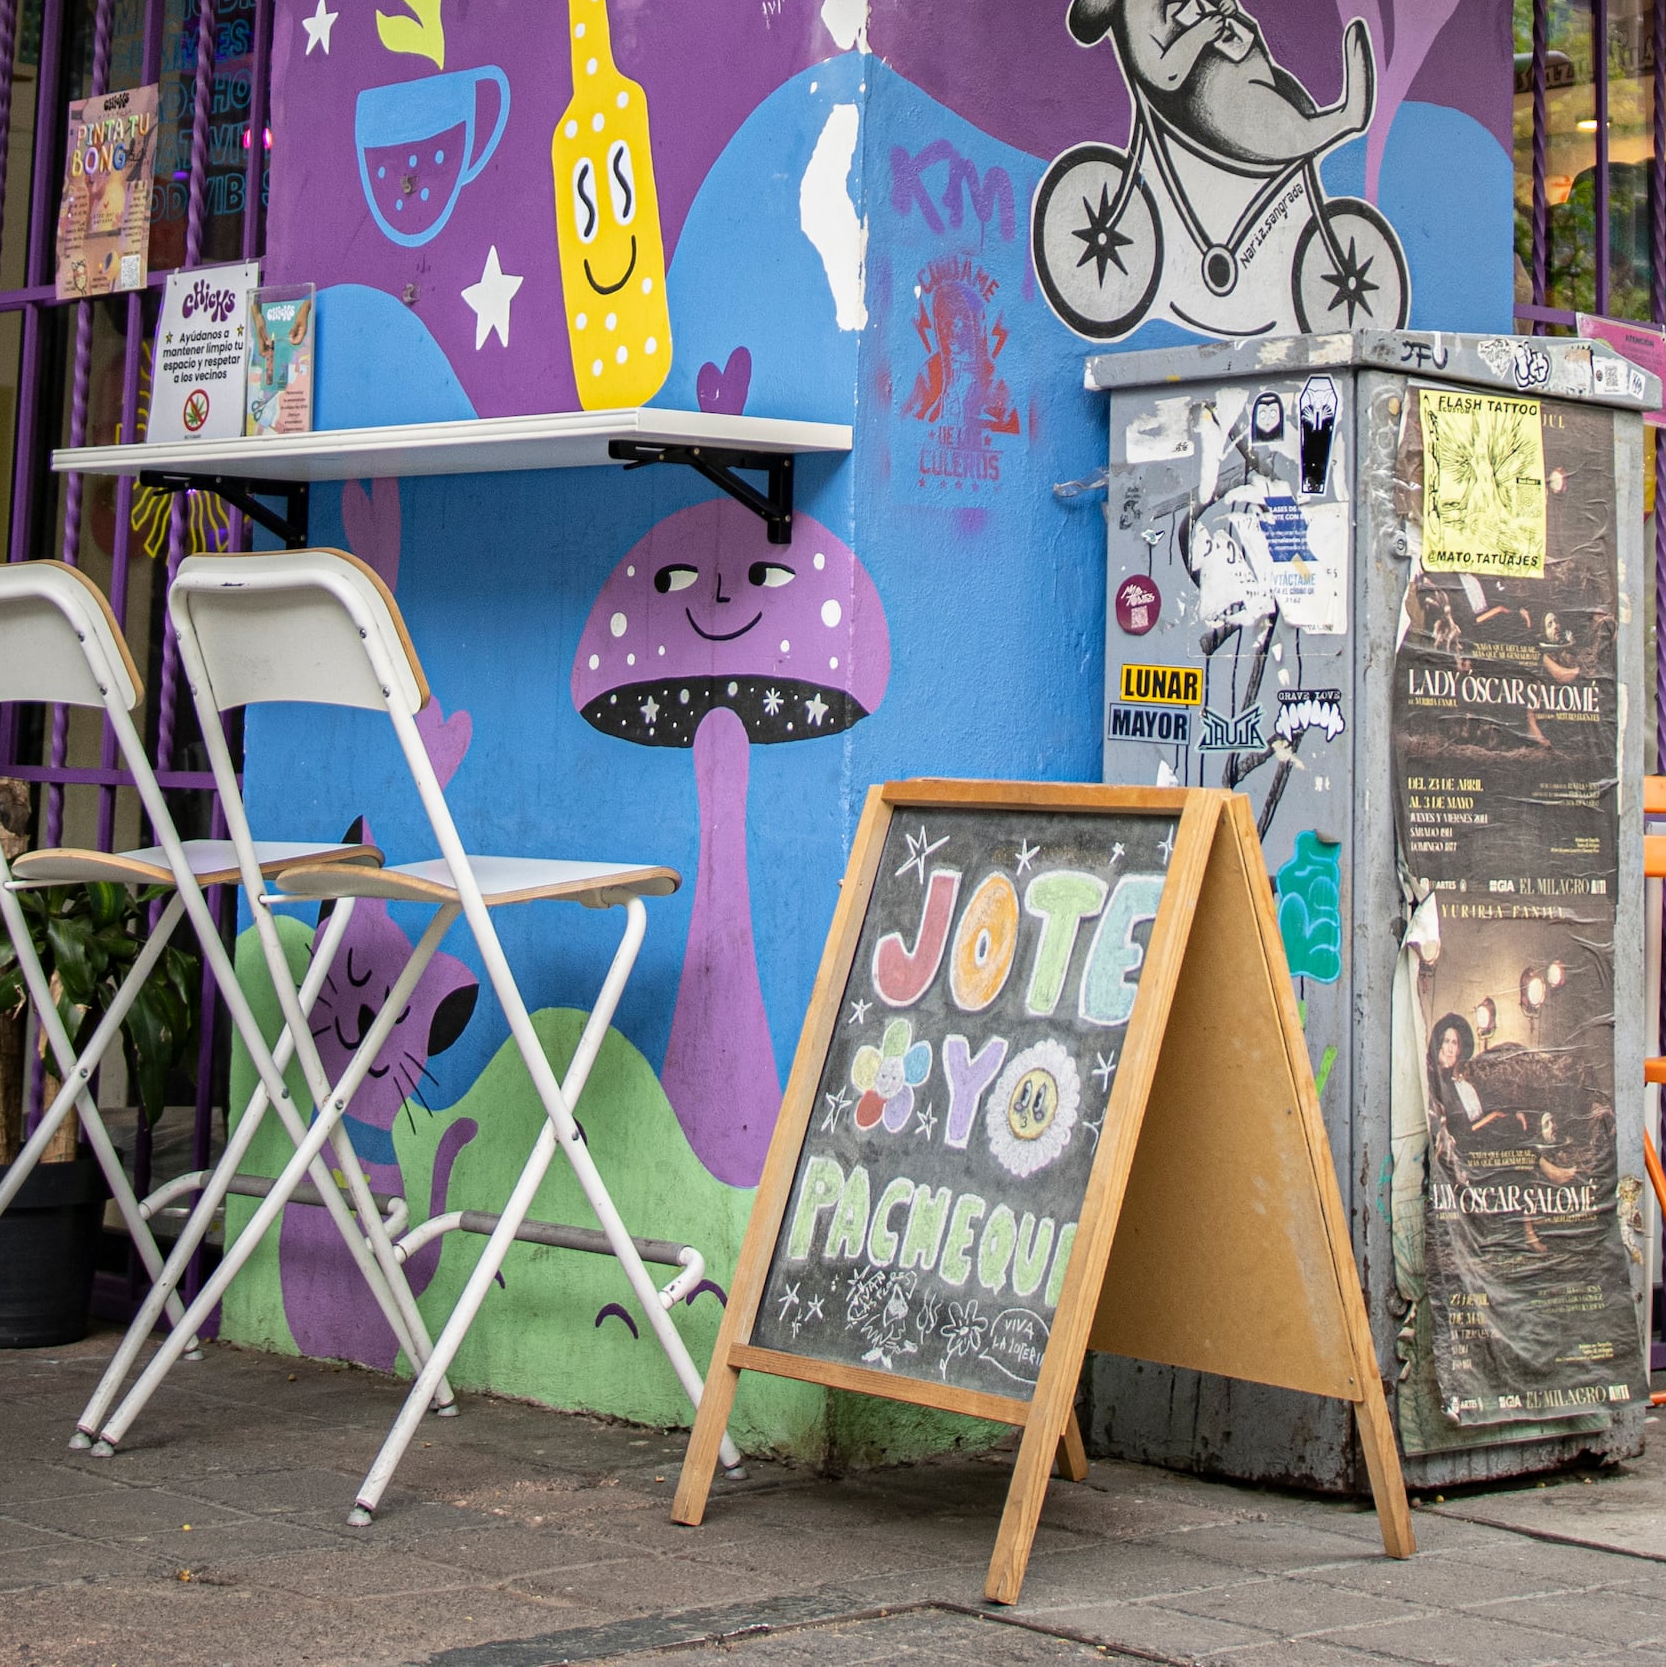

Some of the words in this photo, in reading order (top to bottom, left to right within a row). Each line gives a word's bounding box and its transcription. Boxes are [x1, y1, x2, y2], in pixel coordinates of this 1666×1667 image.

[77, 118, 124, 148] PINTA
[128, 112, 150, 138] TU
[71, 142, 126, 177] BONG
[179, 330, 222, 346] Ayúdanos
[223, 329, 230, 339] a
[163, 344, 205, 358] mantener
[206, 341, 233, 355] limpio
[234, 340, 244, 351] tu
[163, 357, 196, 373] espacio
[197, 359, 204, 371] y
[204, 354, 241, 369] respetar
[173, 375, 180, 384] a
[181, 372, 194, 383] los
[195, 369, 228, 382] vecinos
[1438, 395, 1482, 411] FLASH
[1488, 400, 1538, 416] TATTOO
[1124, 667, 1199, 702] LUNAR
[1408, 669, 1460, 697] LADY
[1461, 669, 1526, 705] ÓSCAR
[1527, 680, 1600, 712] SALOMÉ
[1278, 690, 1310, 701] GRAVE
[1314, 690, 1341, 701] LOVE
[1111, 708, 1188, 741] MAYOR
[1408, 777, 1427, 790] DEL
[1441, 778, 1455, 791] DE
[1457, 778, 1484, 792] ABRIL
[1409, 796, 1422, 809] AL
[1423, 797, 1431, 809] 3
[1431, 797, 1445, 809] DE
[1446, 797, 1474, 810] MAYO
[1435, 880, 1457, 890] ARTES
[1520, 878, 1534, 895] EL
[1537, 878, 1590, 895] MILAGRO
[872, 869, 1167, 1027] JOTE
[1523, 1178, 1597, 1215] SALOMÉ
[1004, 1318, 1035, 1341] VIVA
[993, 1335, 1008, 1350] LA
[1525, 1390, 1539, 1409] EL
[1542, 1384, 1607, 1408] MILAGRO
